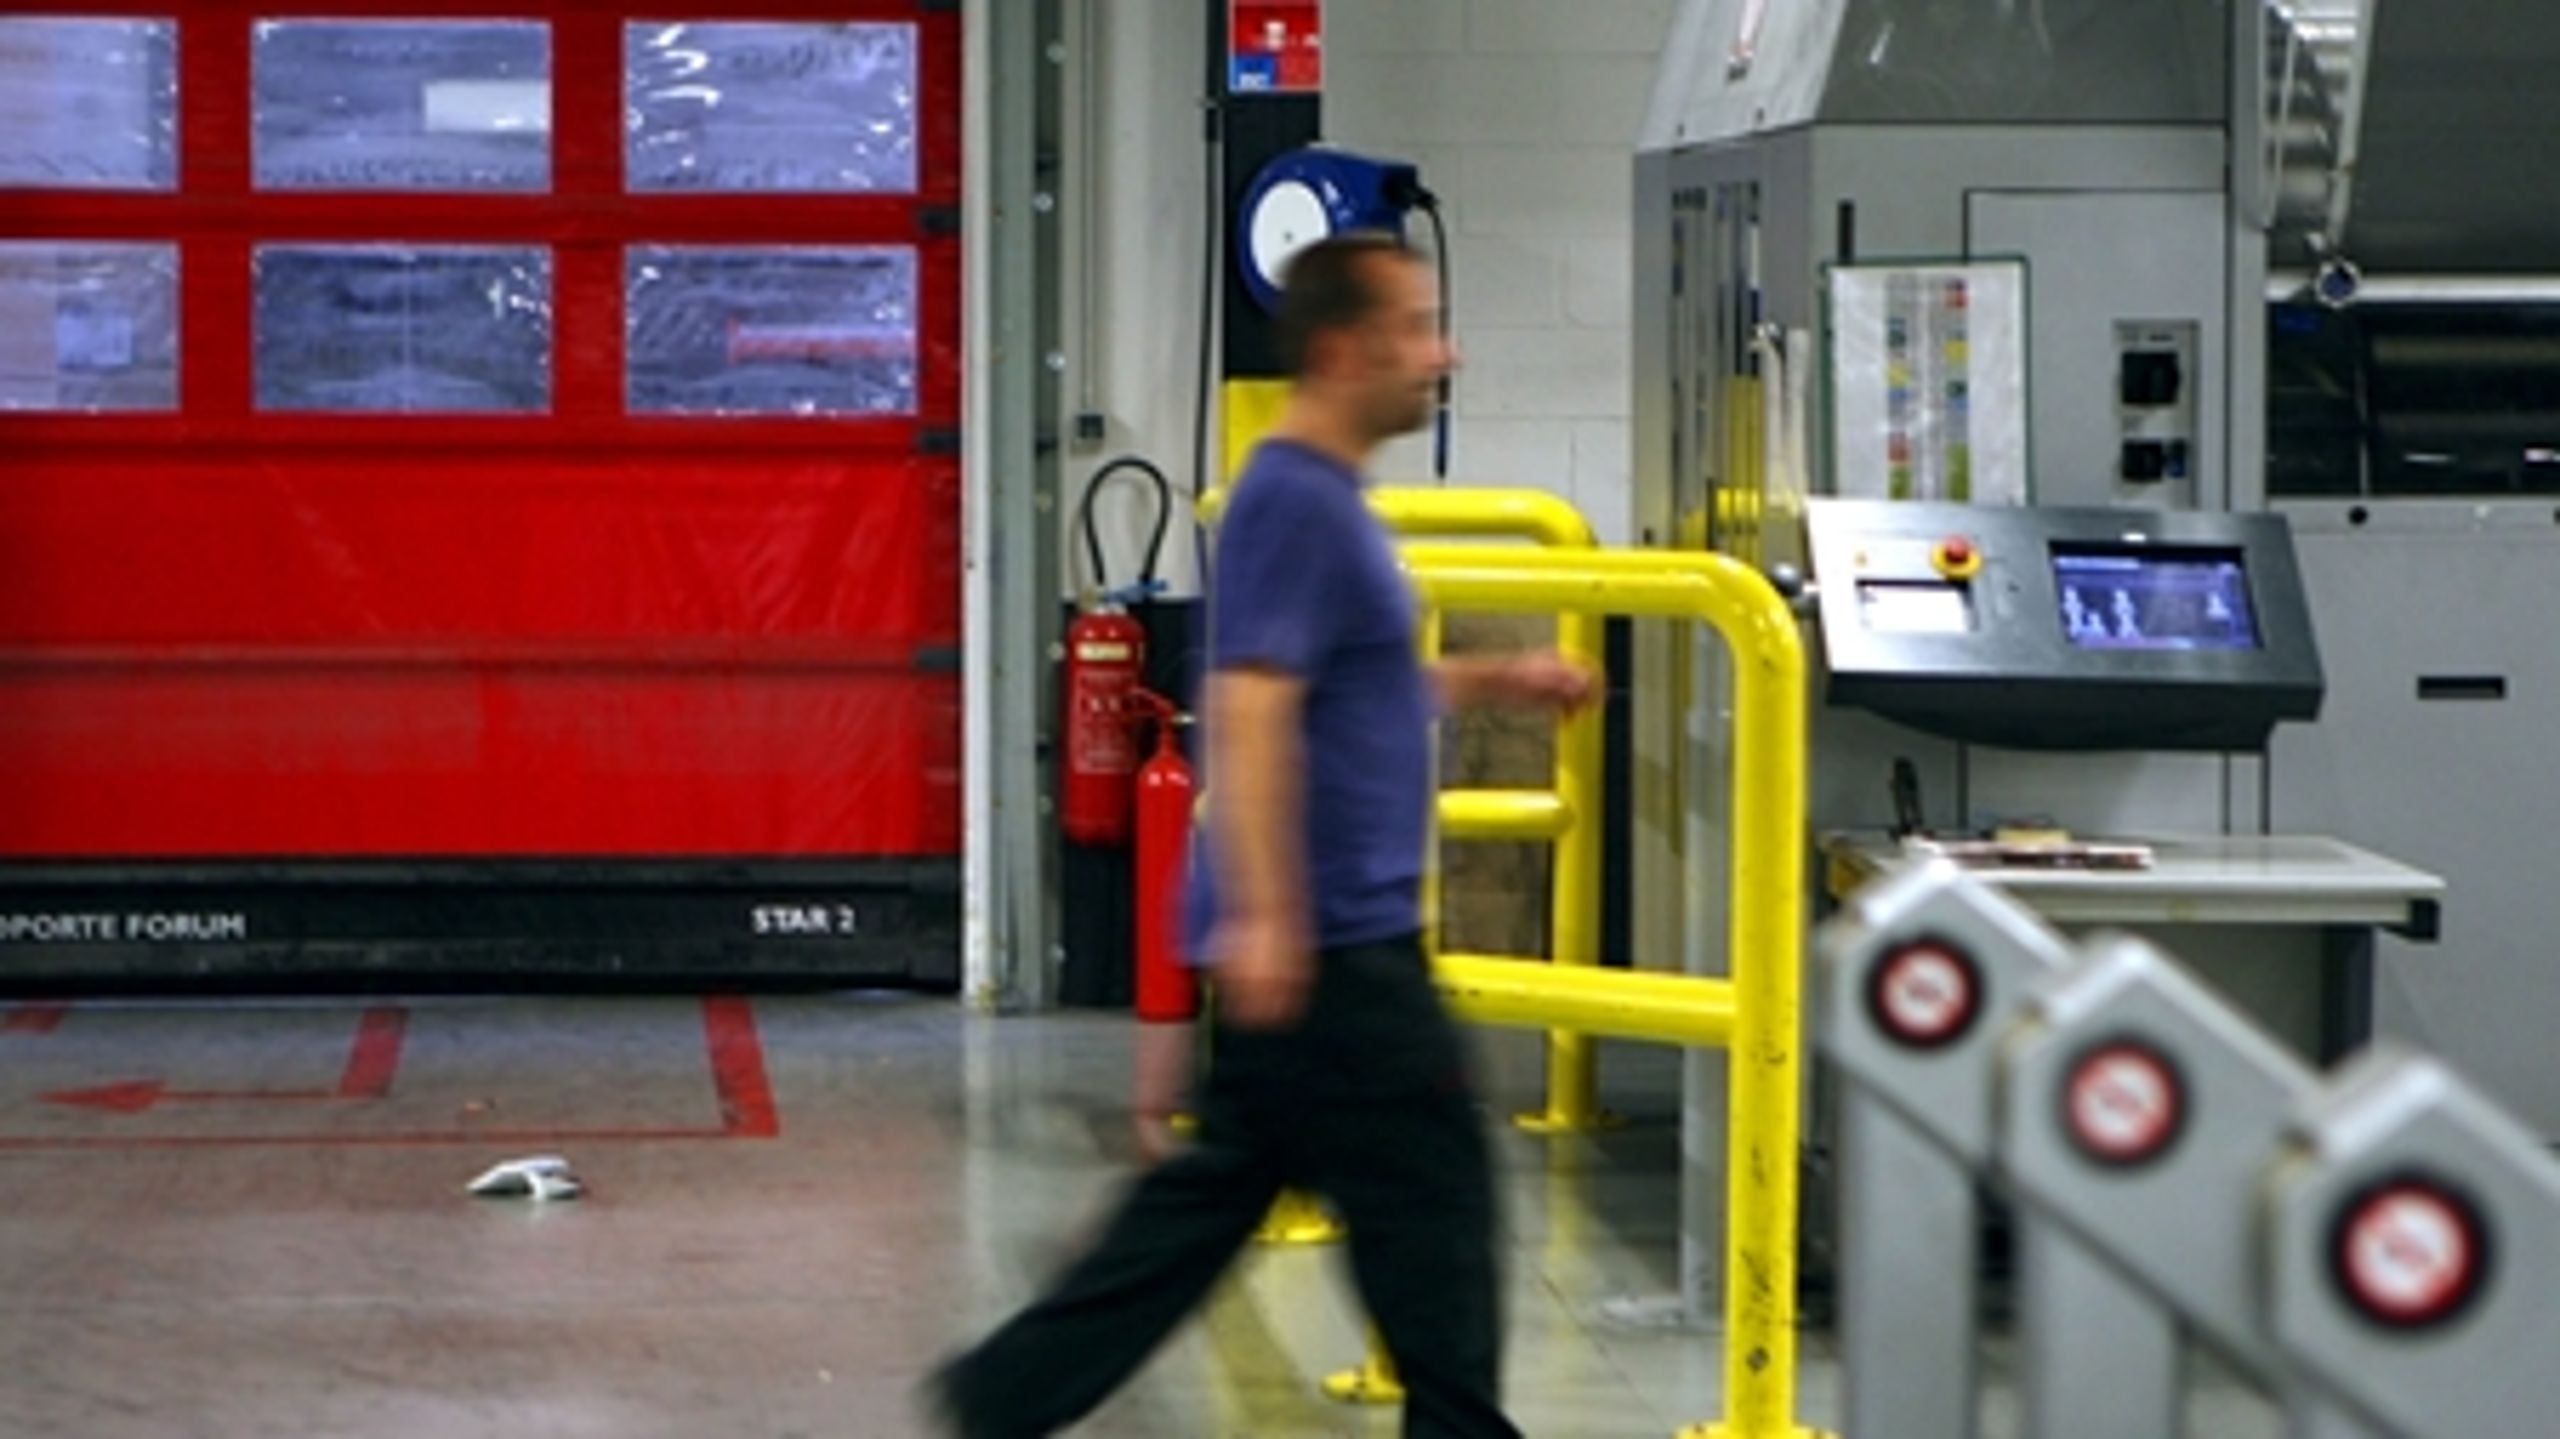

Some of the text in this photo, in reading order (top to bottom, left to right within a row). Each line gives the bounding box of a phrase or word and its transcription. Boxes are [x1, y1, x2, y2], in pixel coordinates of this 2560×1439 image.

[126, 913, 246, 940] FORUM
[752, 904, 855, 933] STAR 2
